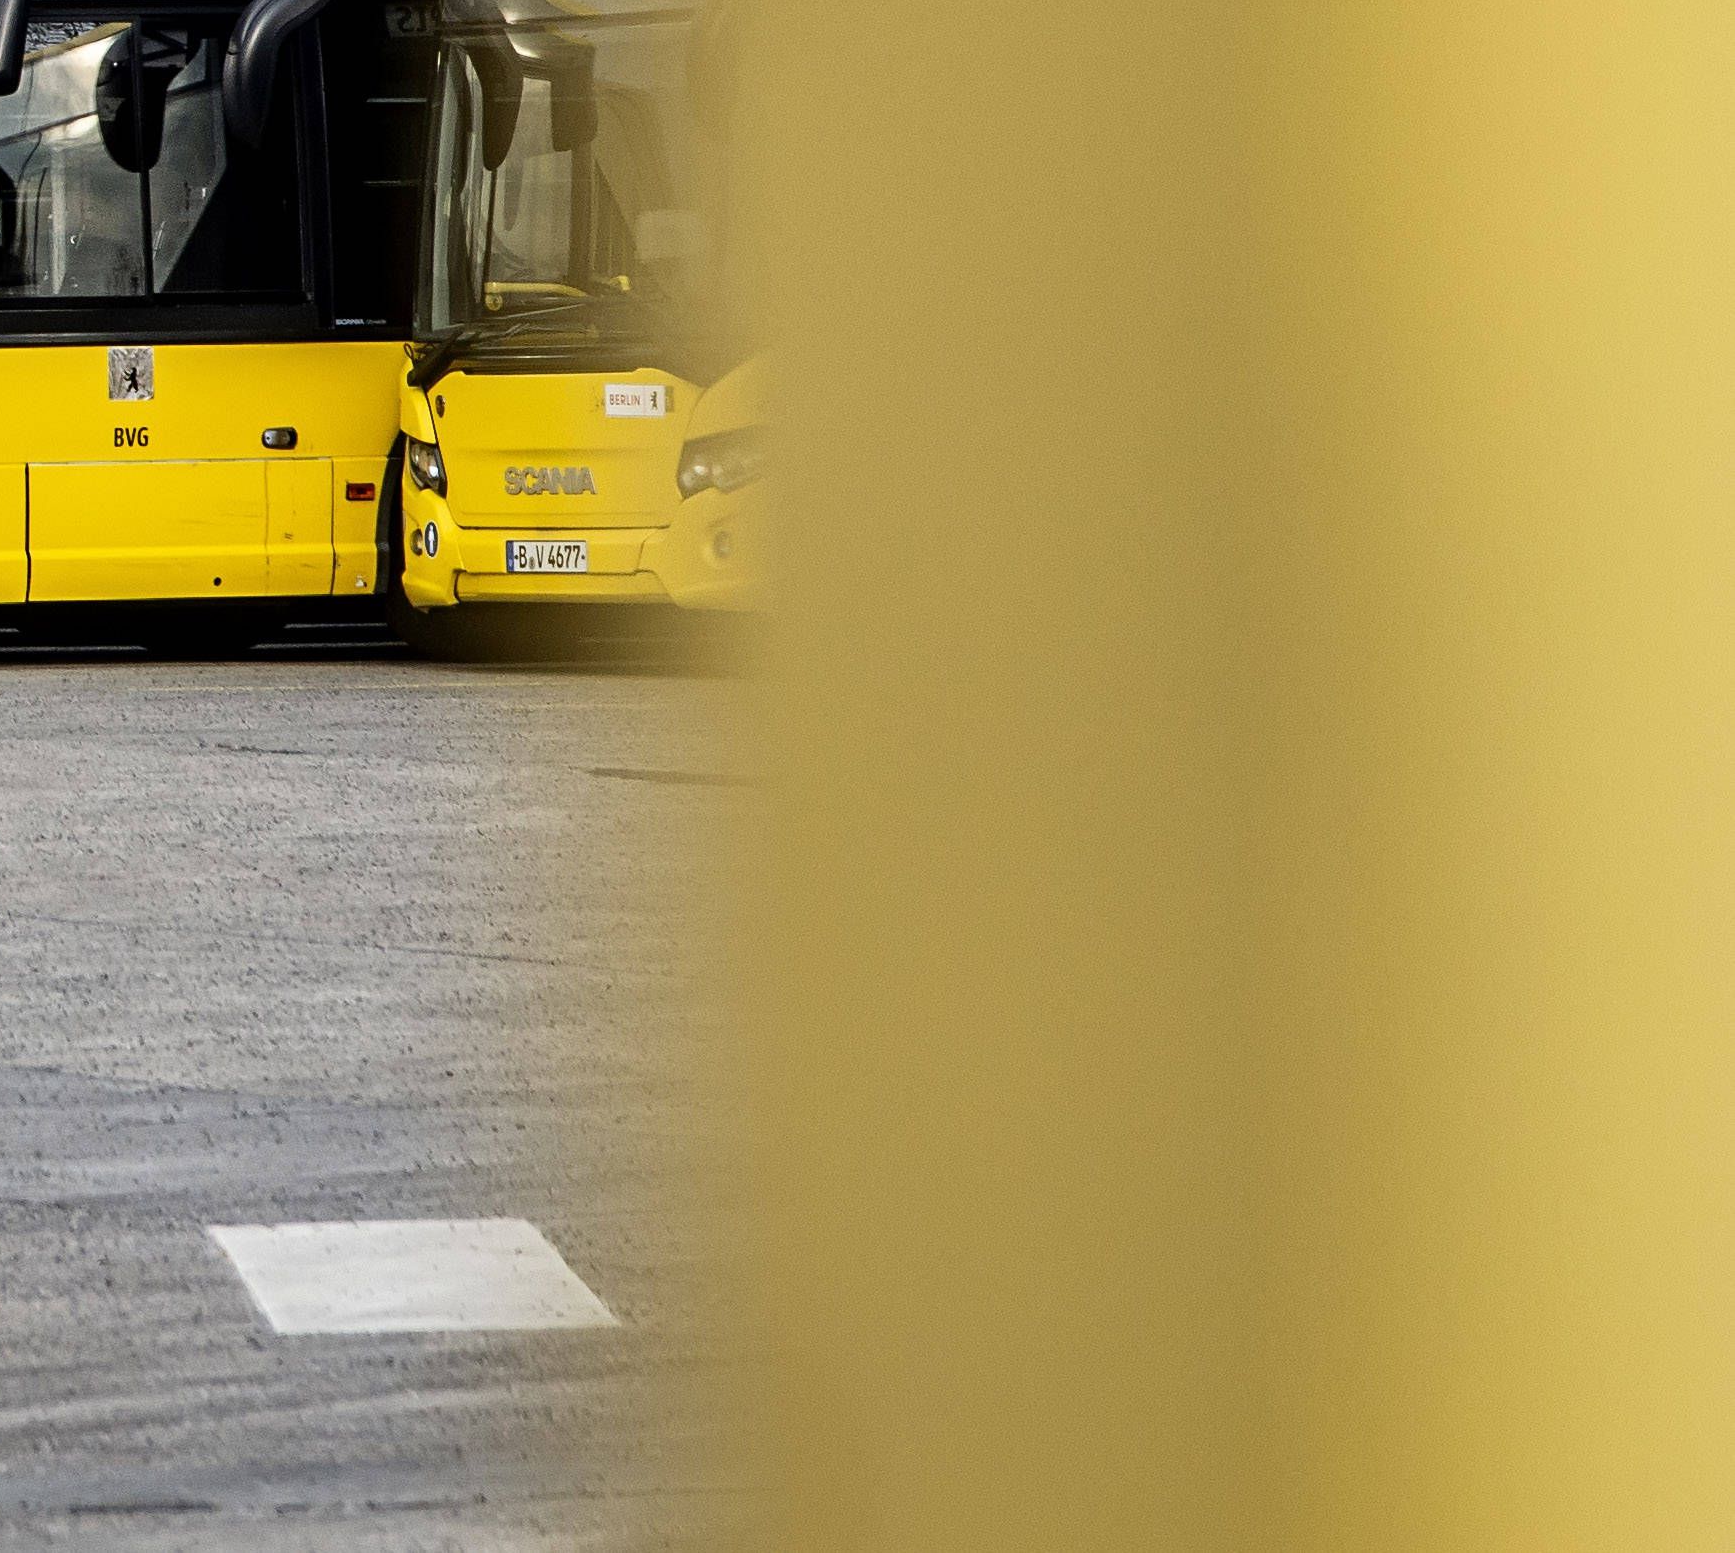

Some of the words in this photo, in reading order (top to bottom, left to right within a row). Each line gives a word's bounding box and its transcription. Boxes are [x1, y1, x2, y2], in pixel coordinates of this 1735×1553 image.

[609, 394, 641, 406] BERLIN
[113, 426, 149, 447] BVG
[504, 466, 598, 496] SCANIA
[547, 544, 581, 567] 4677
